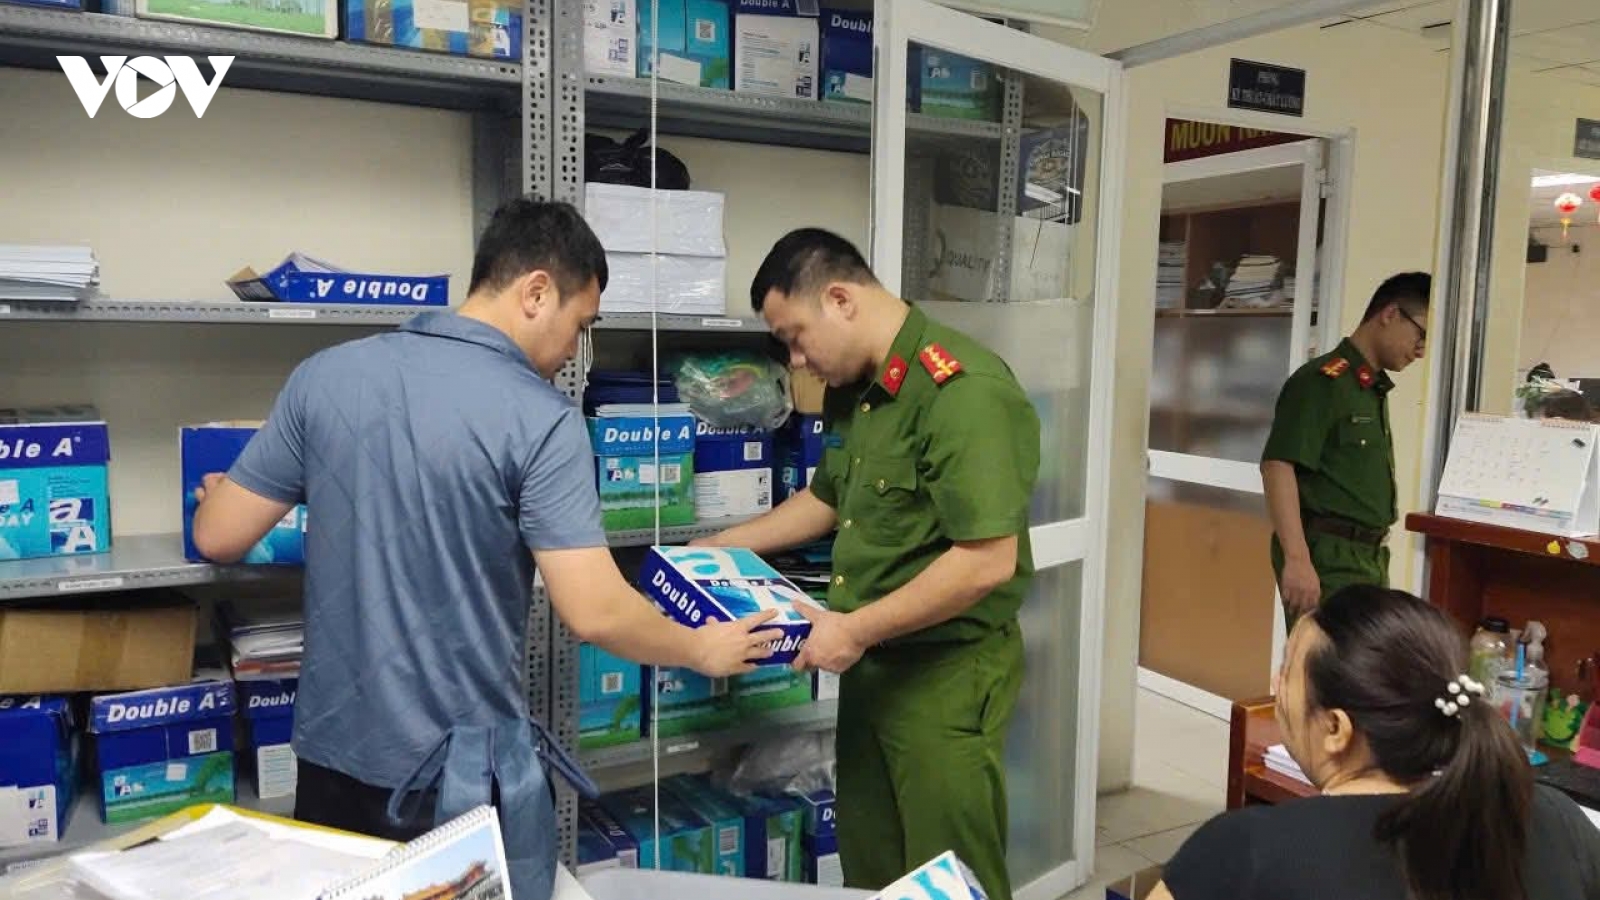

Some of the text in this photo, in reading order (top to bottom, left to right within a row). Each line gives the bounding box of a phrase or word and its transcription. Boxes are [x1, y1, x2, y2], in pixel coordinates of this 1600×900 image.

[831, 14, 872, 33] Doubl
[316, 278, 429, 301] Double A
[604, 426, 690, 443] Double A
[51, 437, 73, 457] A
[652, 569, 701, 623] Double
[107, 692, 215, 723] Double A
